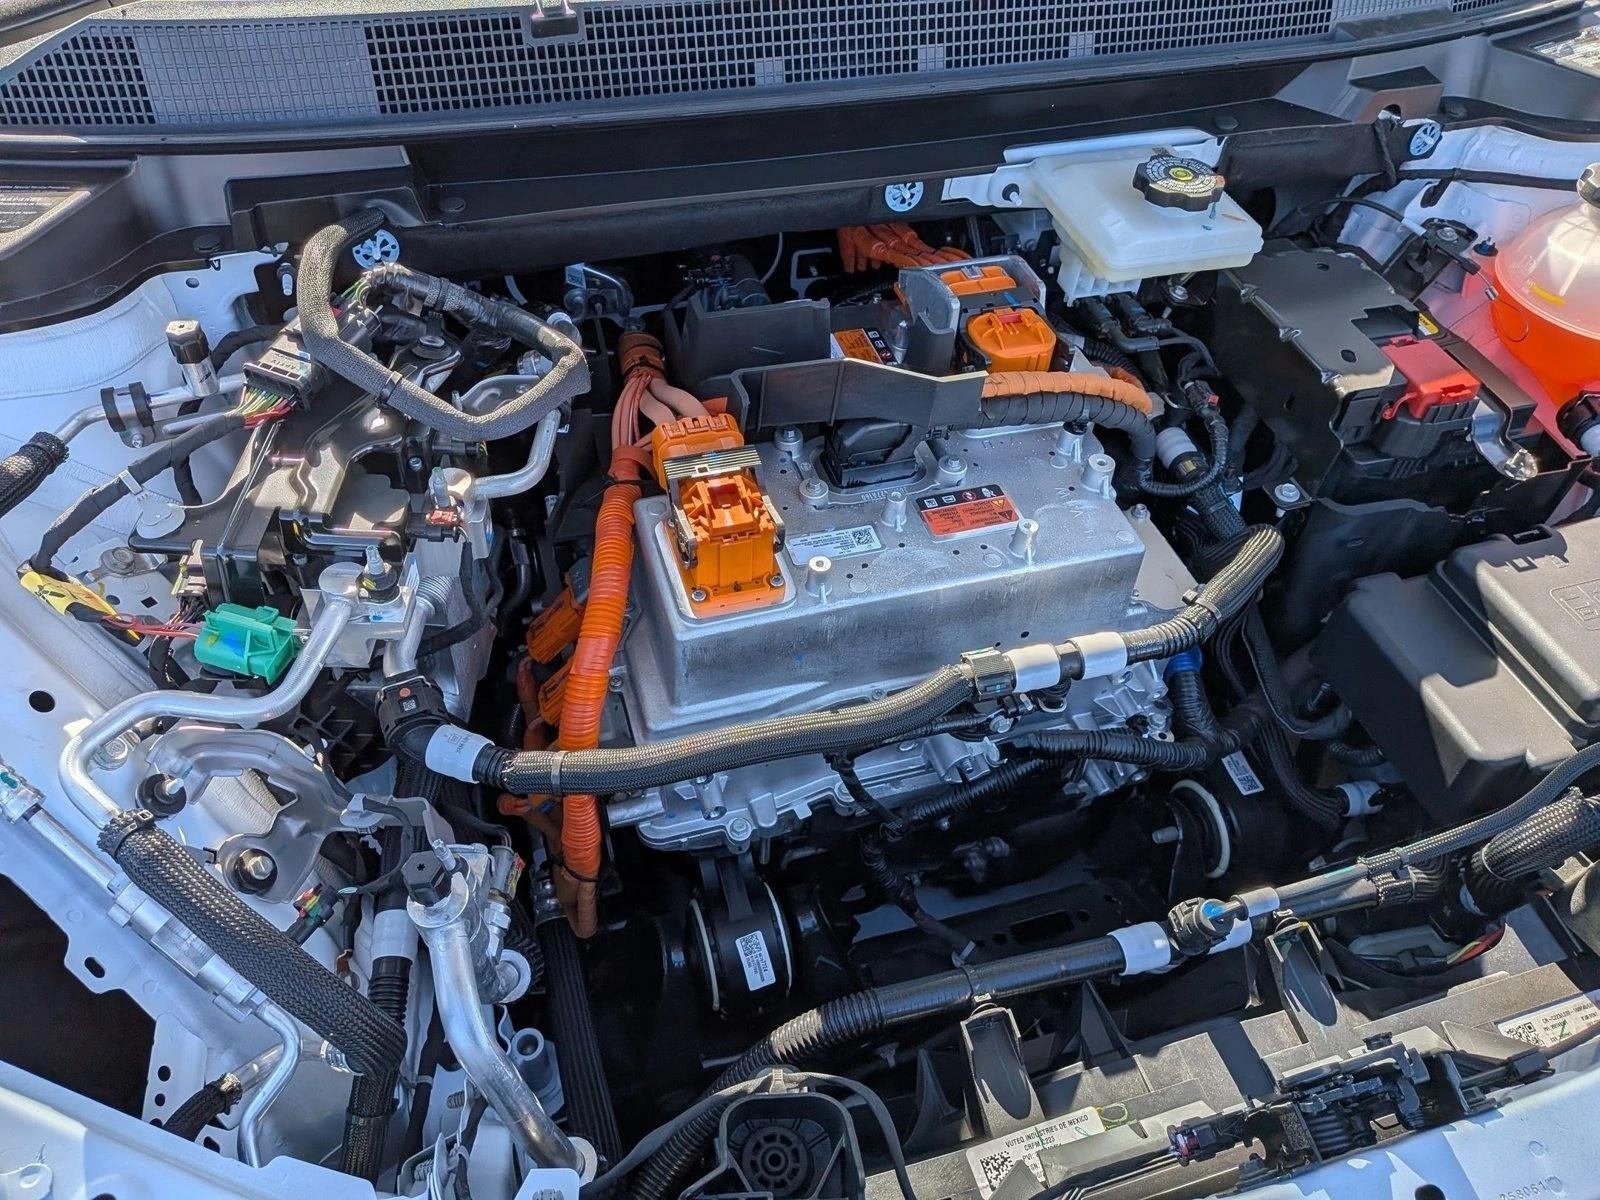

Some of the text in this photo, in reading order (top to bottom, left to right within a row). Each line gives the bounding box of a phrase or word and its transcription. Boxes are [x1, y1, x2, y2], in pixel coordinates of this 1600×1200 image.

[271, 360, 297, 370] APTIV
[1005, 1114, 1089, 1147] VUTEQ INDUSTRIES DE MEXICO
